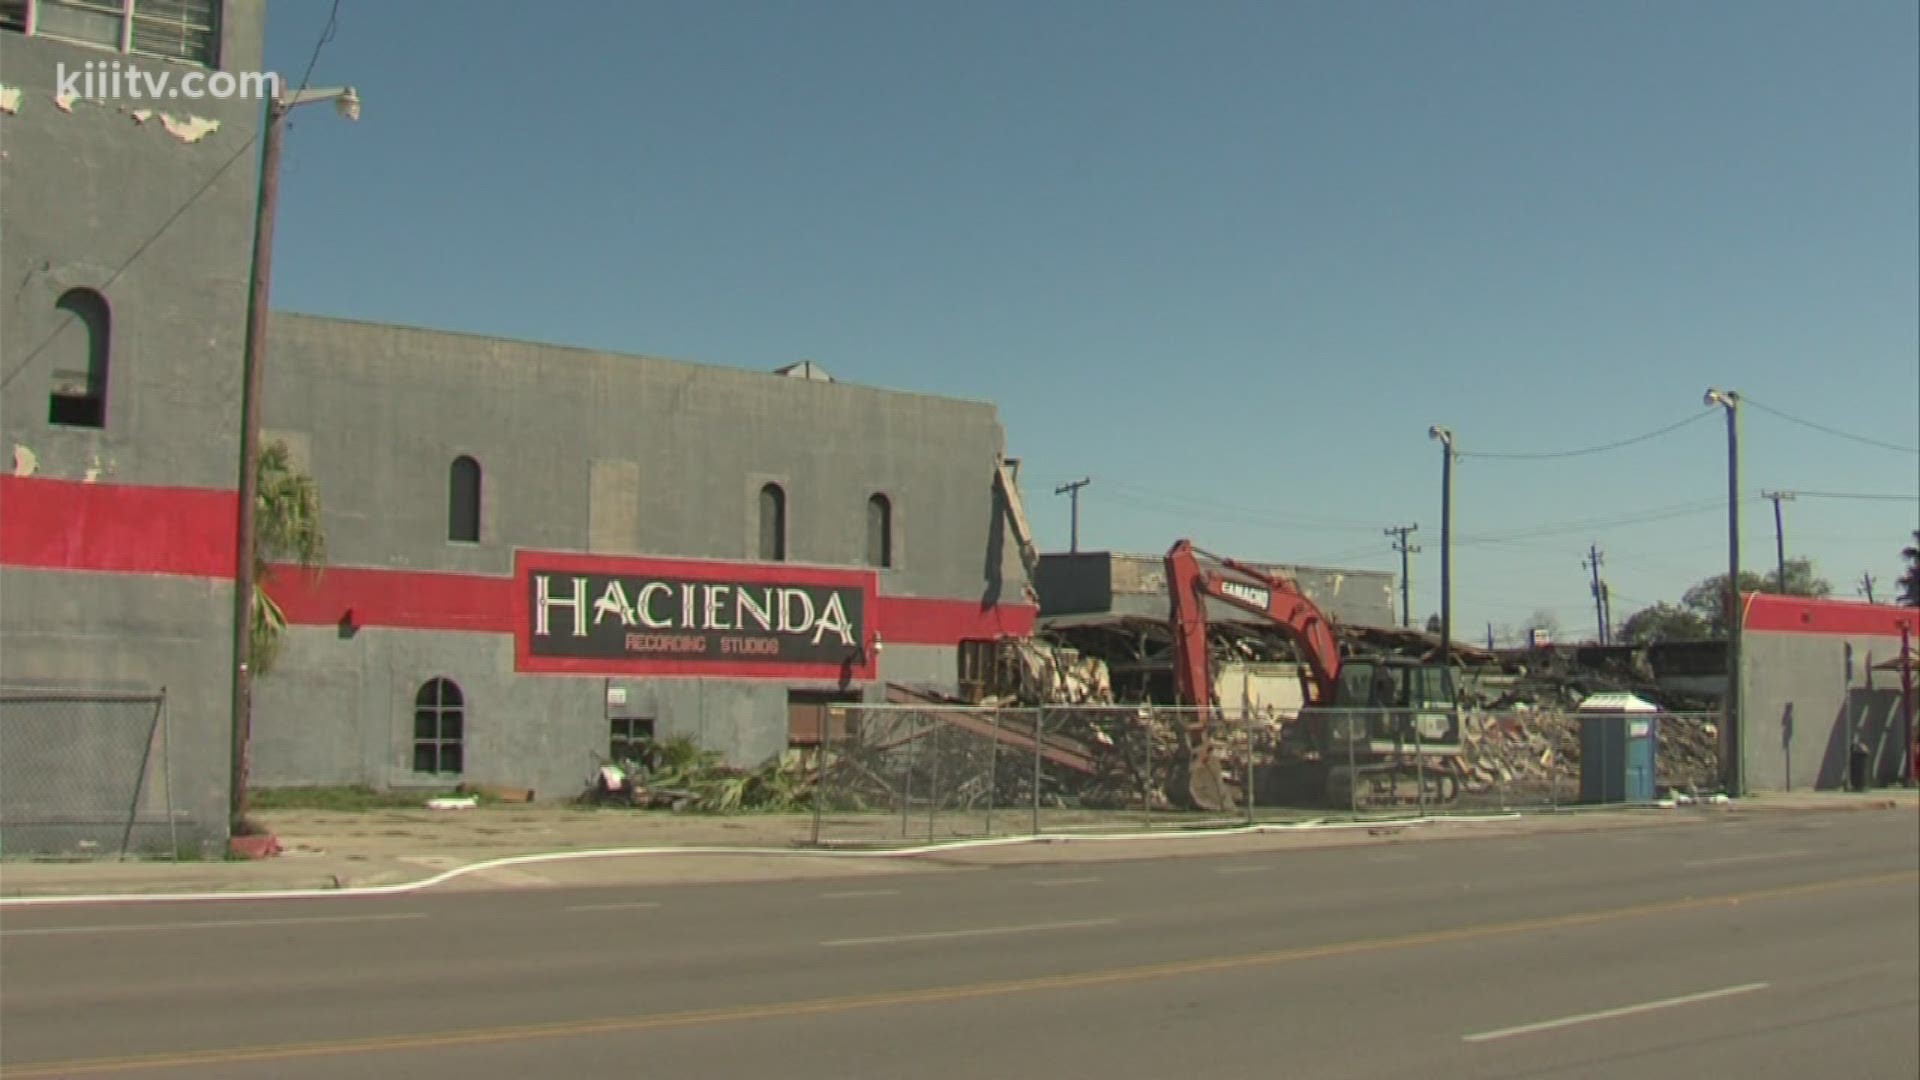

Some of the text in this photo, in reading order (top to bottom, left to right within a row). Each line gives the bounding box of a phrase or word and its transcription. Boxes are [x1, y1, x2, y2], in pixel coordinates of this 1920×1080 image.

[534, 575, 856, 645] HACIENDA
[625, 633, 779, 654] RECORDING STUDIOS
